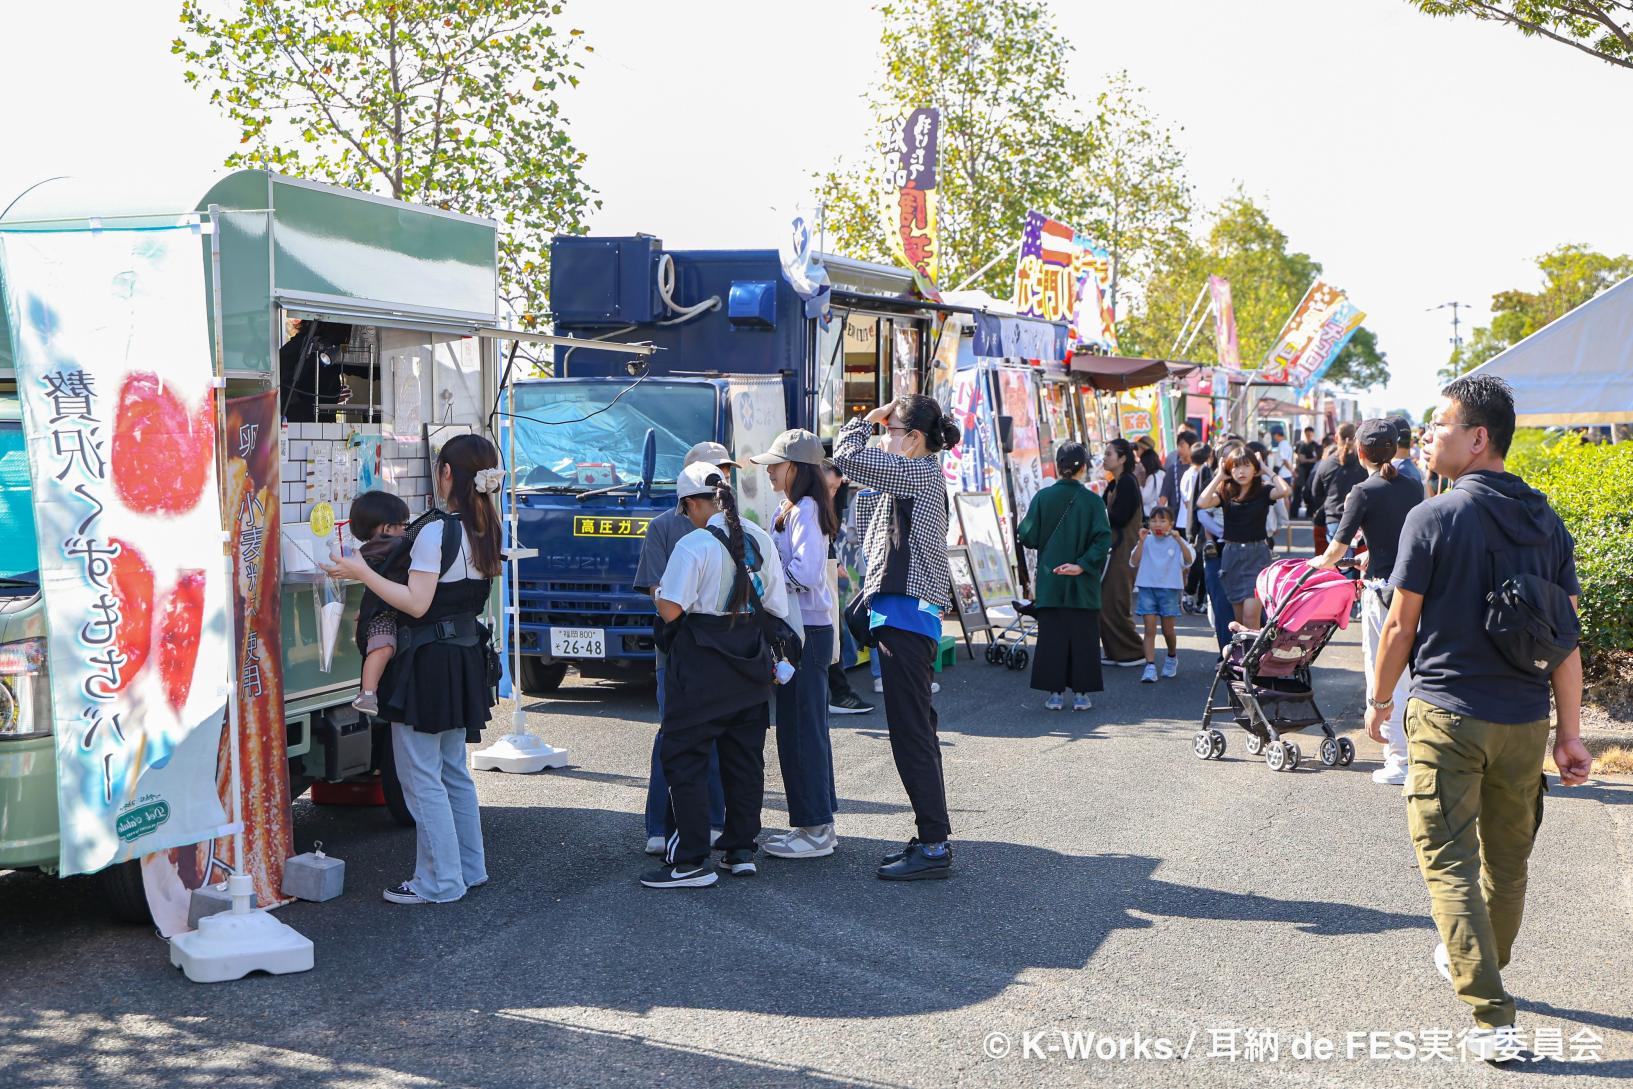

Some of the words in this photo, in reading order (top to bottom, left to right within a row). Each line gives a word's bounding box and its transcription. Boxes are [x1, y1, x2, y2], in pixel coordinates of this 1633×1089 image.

[581, 519, 649, 534] 高圧ガス
[238, 424, 264, 698] 卵・小麦使用
[547, 556, 609, 569] ISUZU
[563, 639, 602, 655] 26-48
